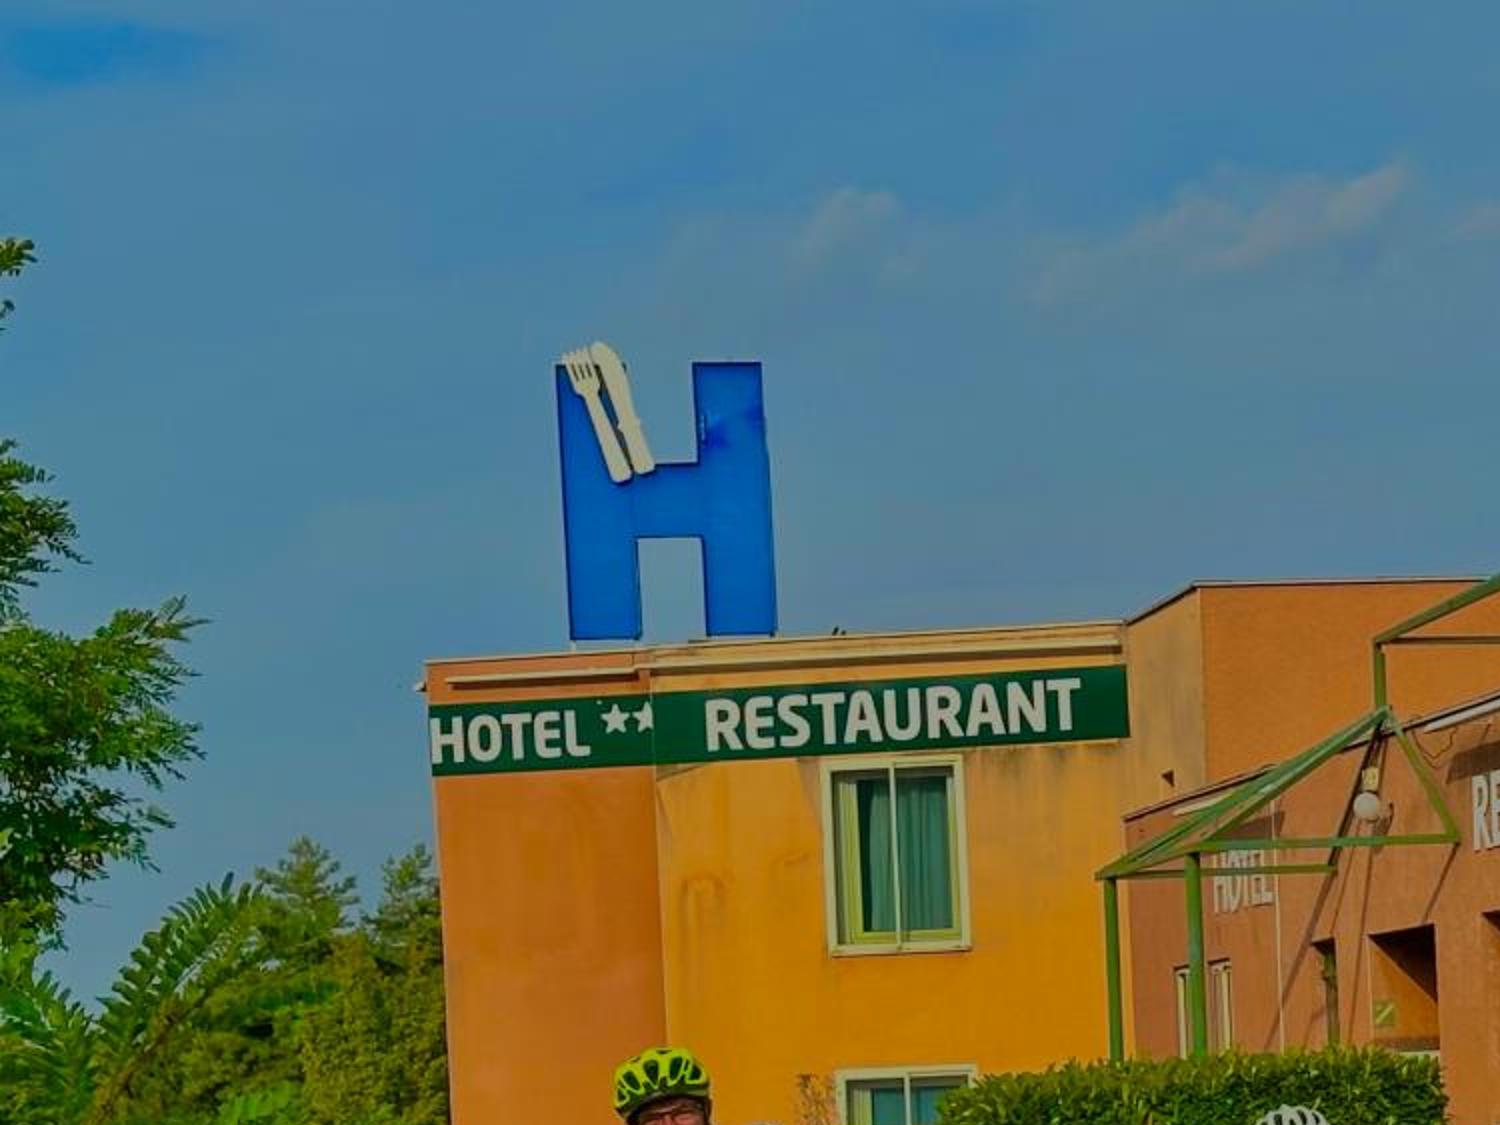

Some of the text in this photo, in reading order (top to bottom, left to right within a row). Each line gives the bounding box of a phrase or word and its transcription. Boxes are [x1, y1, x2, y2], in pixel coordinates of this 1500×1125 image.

[430, 677, 1082, 764] HOTEL RESTAURANT
[1213, 849, 1274, 914] HOTEL
